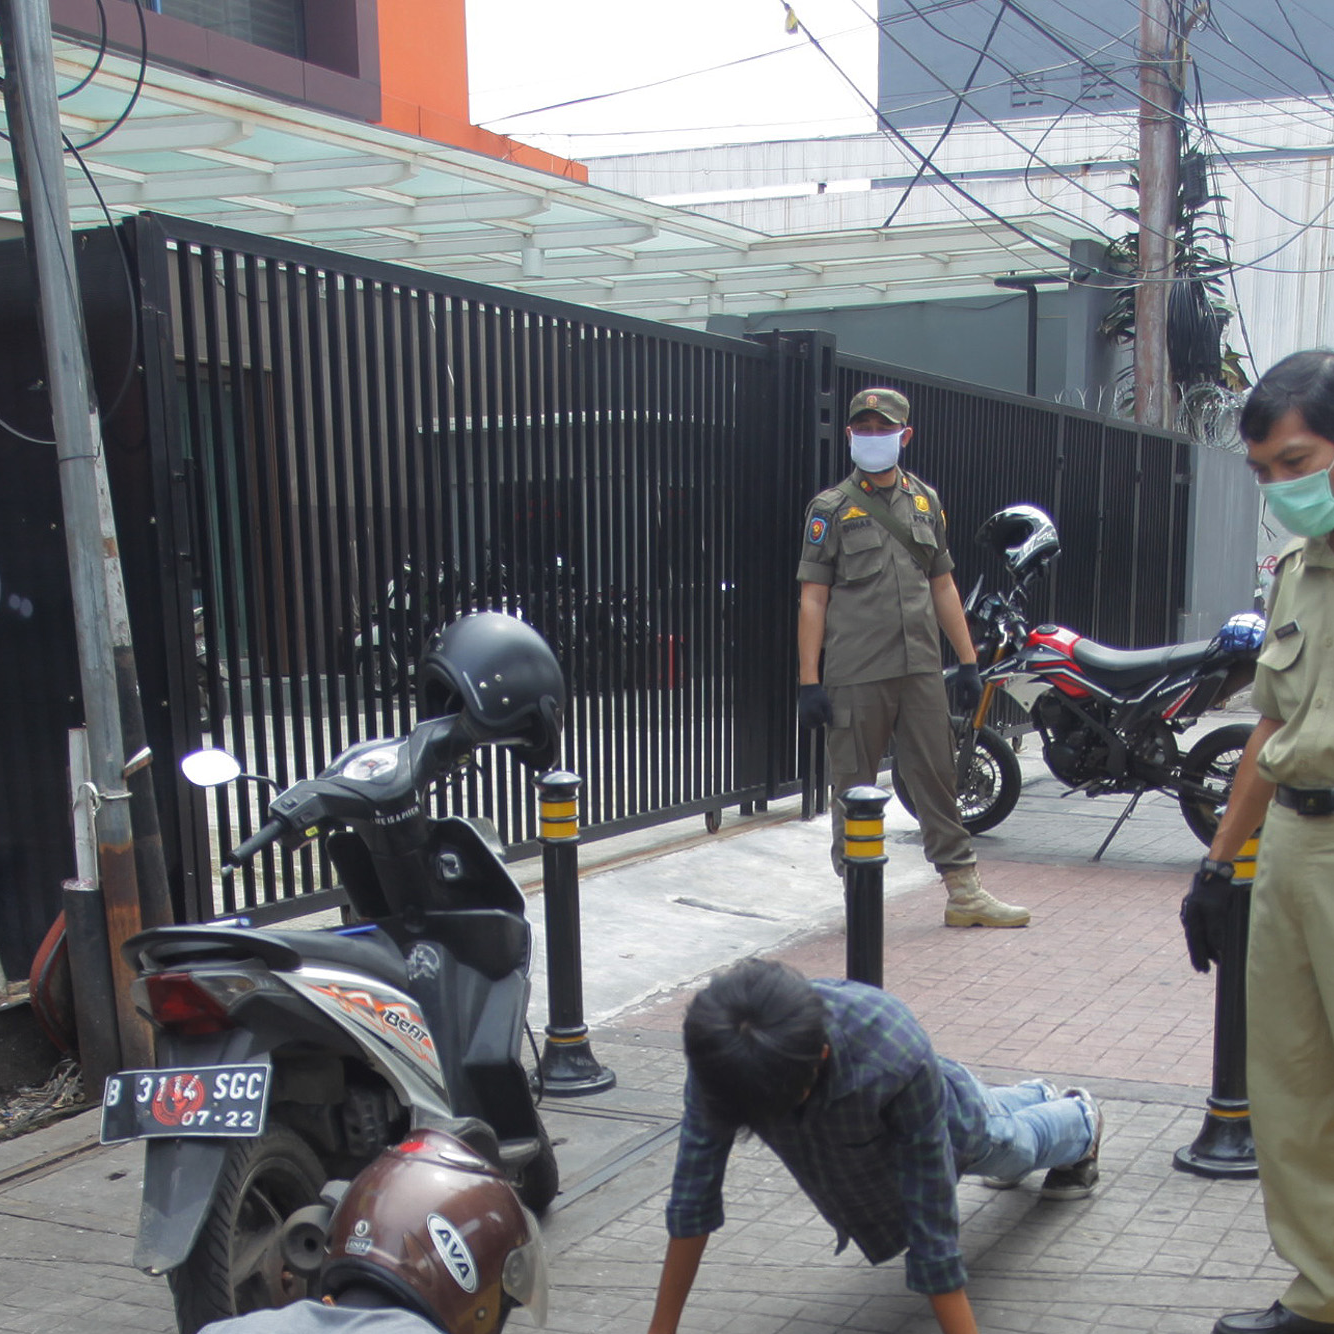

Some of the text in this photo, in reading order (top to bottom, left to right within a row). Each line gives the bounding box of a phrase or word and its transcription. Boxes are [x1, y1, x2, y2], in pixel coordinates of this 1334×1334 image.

[106, 1078, 122, 1107] B
[213, 1072, 262, 1100] SGC
[434, 1229, 470, 1281] AVA
